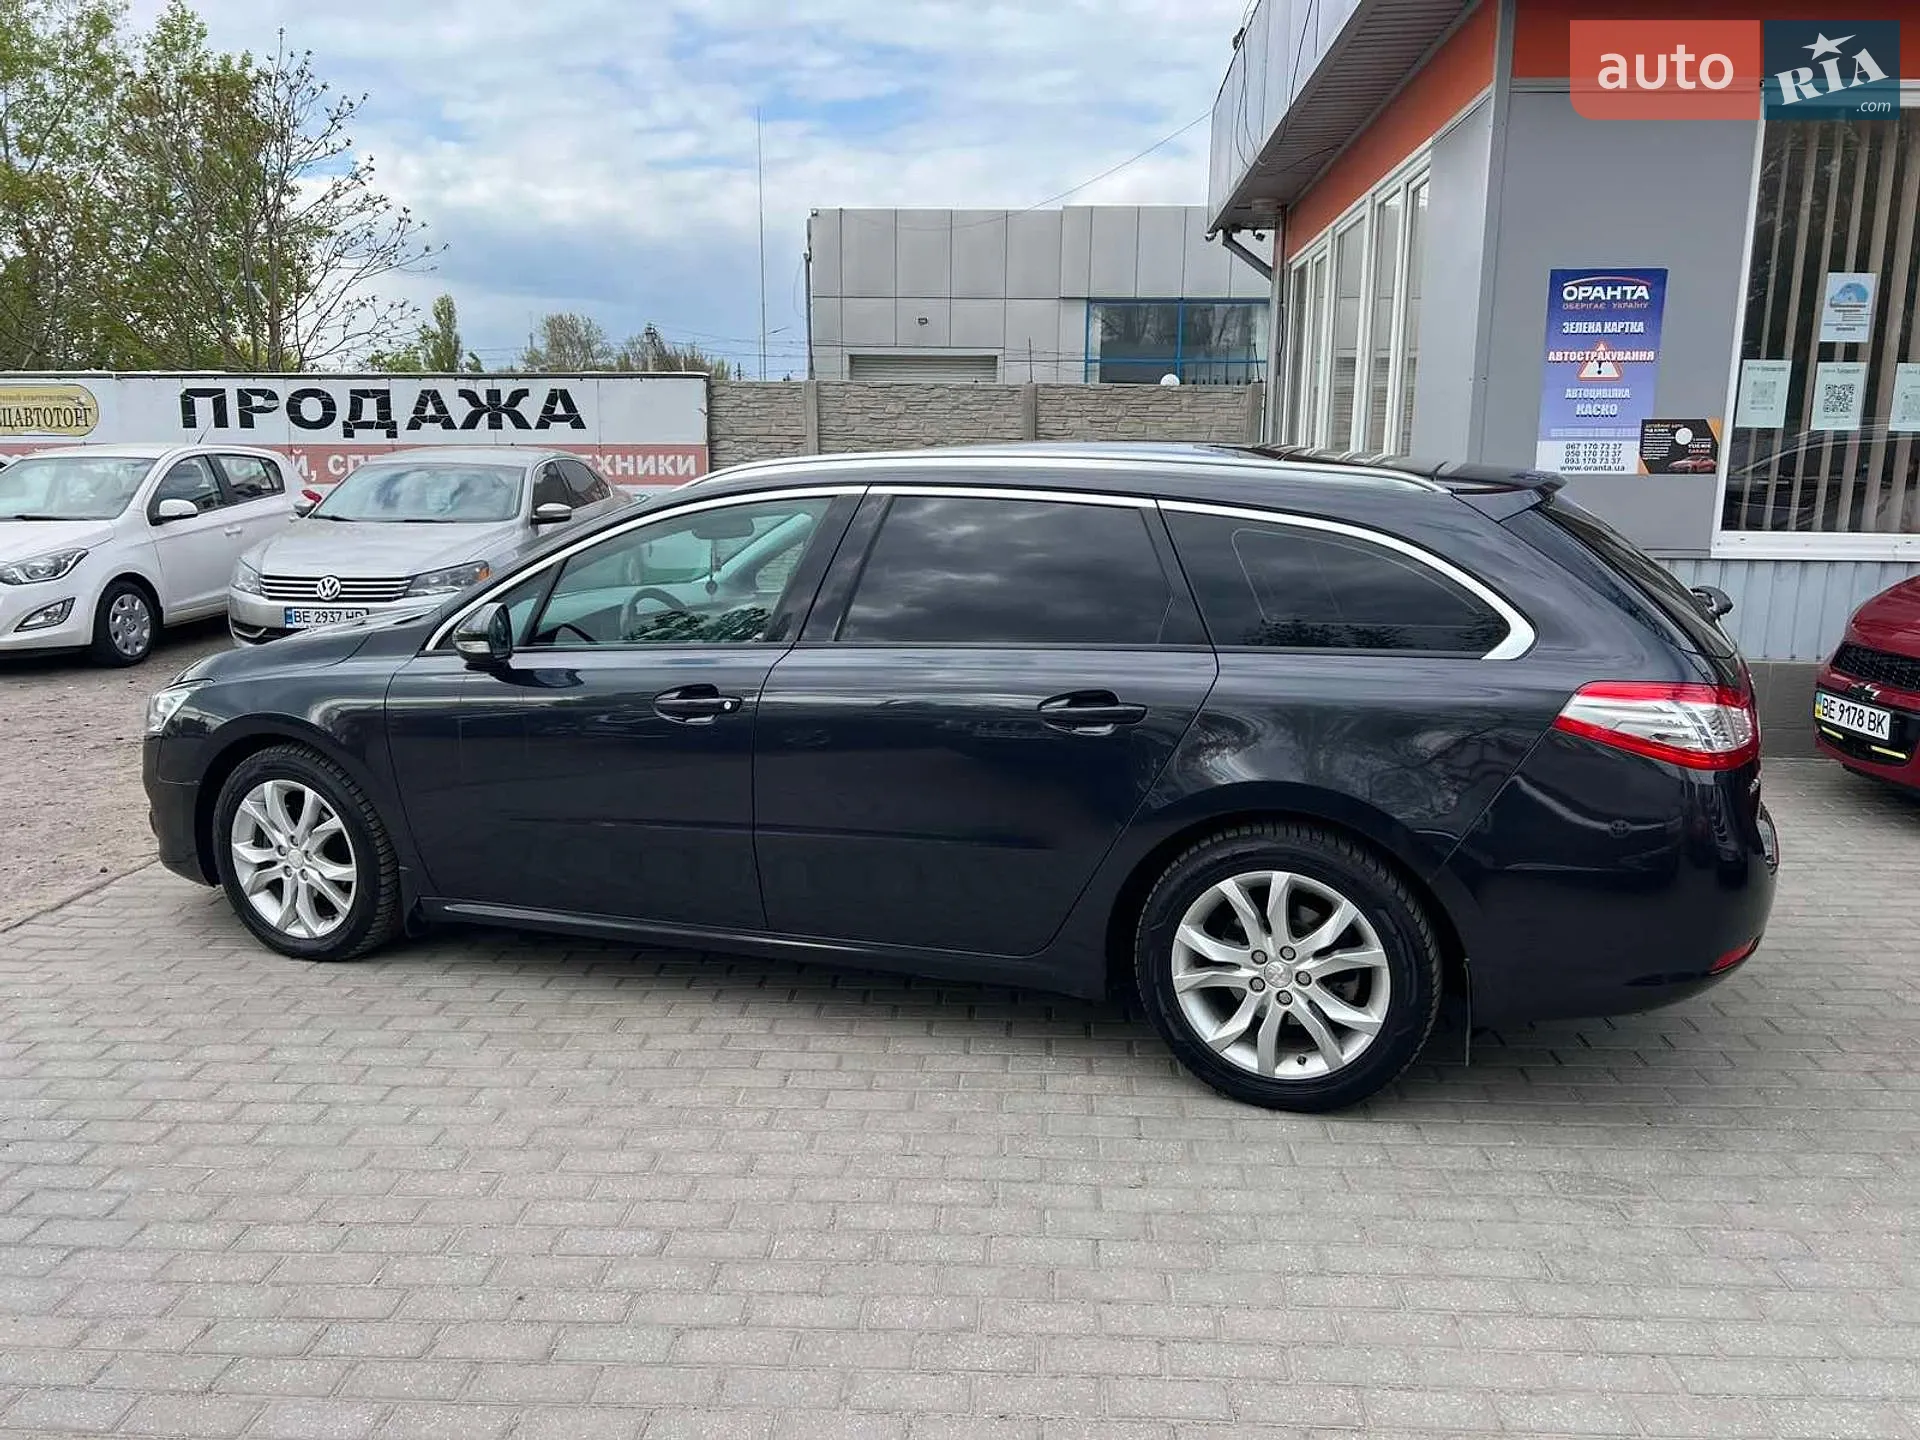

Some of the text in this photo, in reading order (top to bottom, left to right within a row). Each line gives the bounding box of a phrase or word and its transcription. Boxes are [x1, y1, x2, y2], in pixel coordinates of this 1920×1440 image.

[1562, 285, 1650, 301] ОРАНТА
[1562, 321, 1645, 334] ЗЕЛЕНА КАРТКА
[1548, 350, 1655, 362] АВТОСТРАХУВАННЯ
[180, 387, 587, 439] ПРОДАЖА
[1576, 403, 1618, 417] КАСКО
[0, 407, 92, 430] ЦАВТОТОРГ
[1560, 464, 1625, 472] www.oranta.ua
[294, 610, 311, 623] BE
[314, 610, 342, 623] 2937
[1822, 698, 1887, 735] BE 9178 BK
